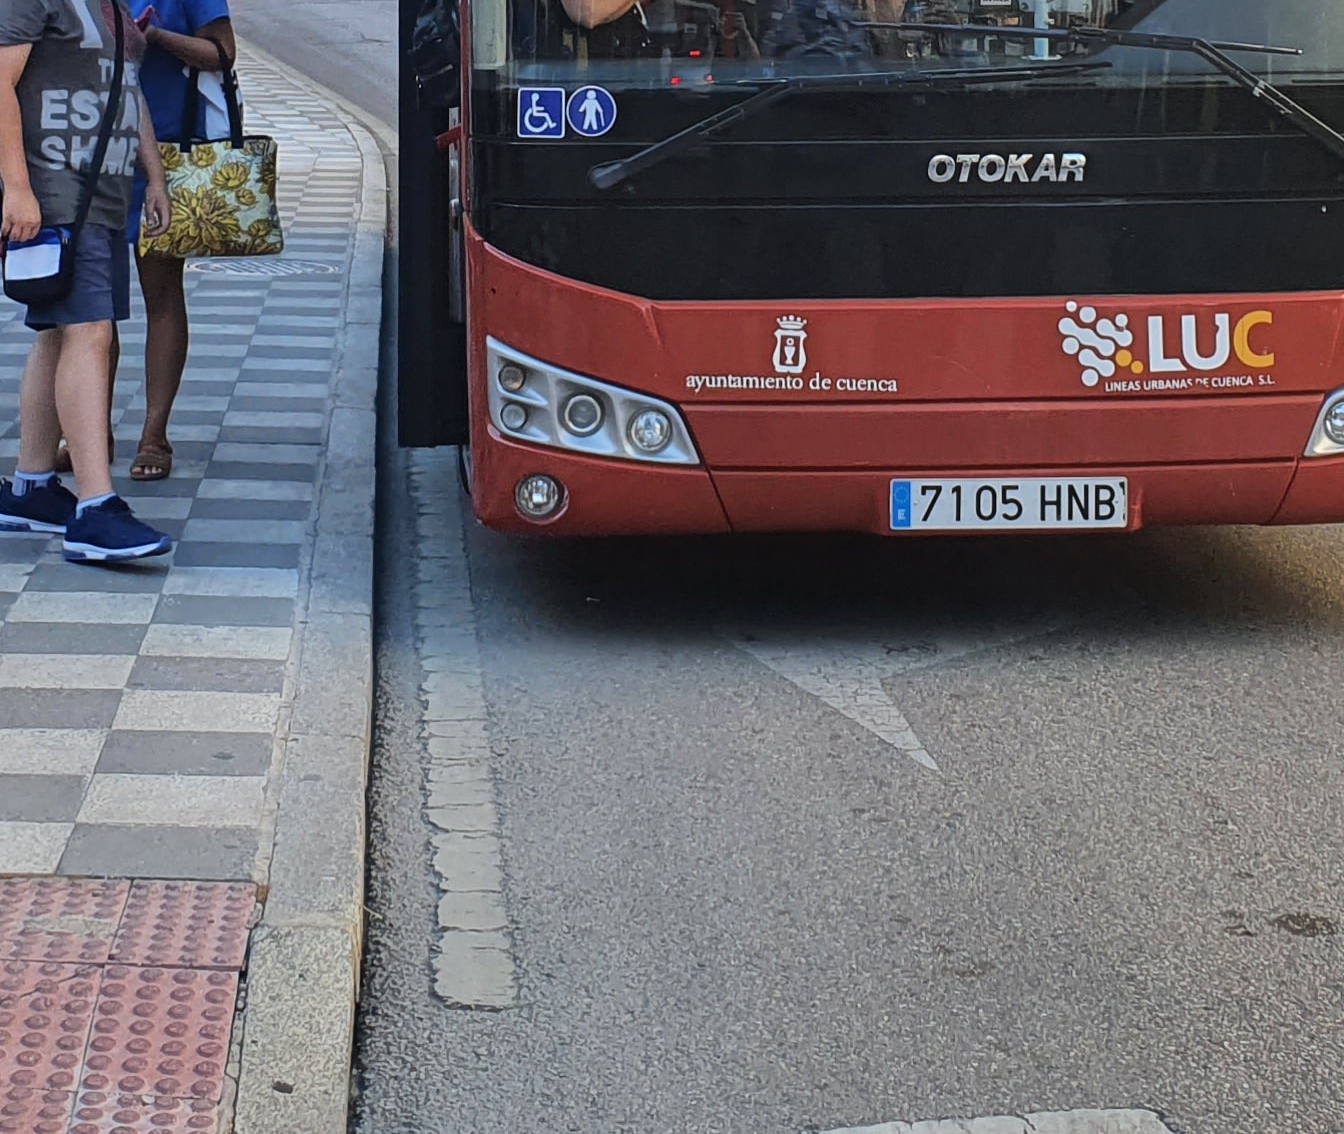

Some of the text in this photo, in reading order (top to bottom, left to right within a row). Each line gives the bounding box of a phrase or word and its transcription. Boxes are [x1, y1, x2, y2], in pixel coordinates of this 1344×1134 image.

[928, 153, 1087, 183] OTOKAR
[1147, 310, 1275, 373] LUC
[686, 372, 898, 393] ayuntamiento de cuenca
[1105, 380, 1142, 392] LINEAS
[1143, 378, 1193, 391] URBANAS
[1211, 375, 1254, 388] CUENCA
[897, 484, 1116, 522] E 7105 HNB
